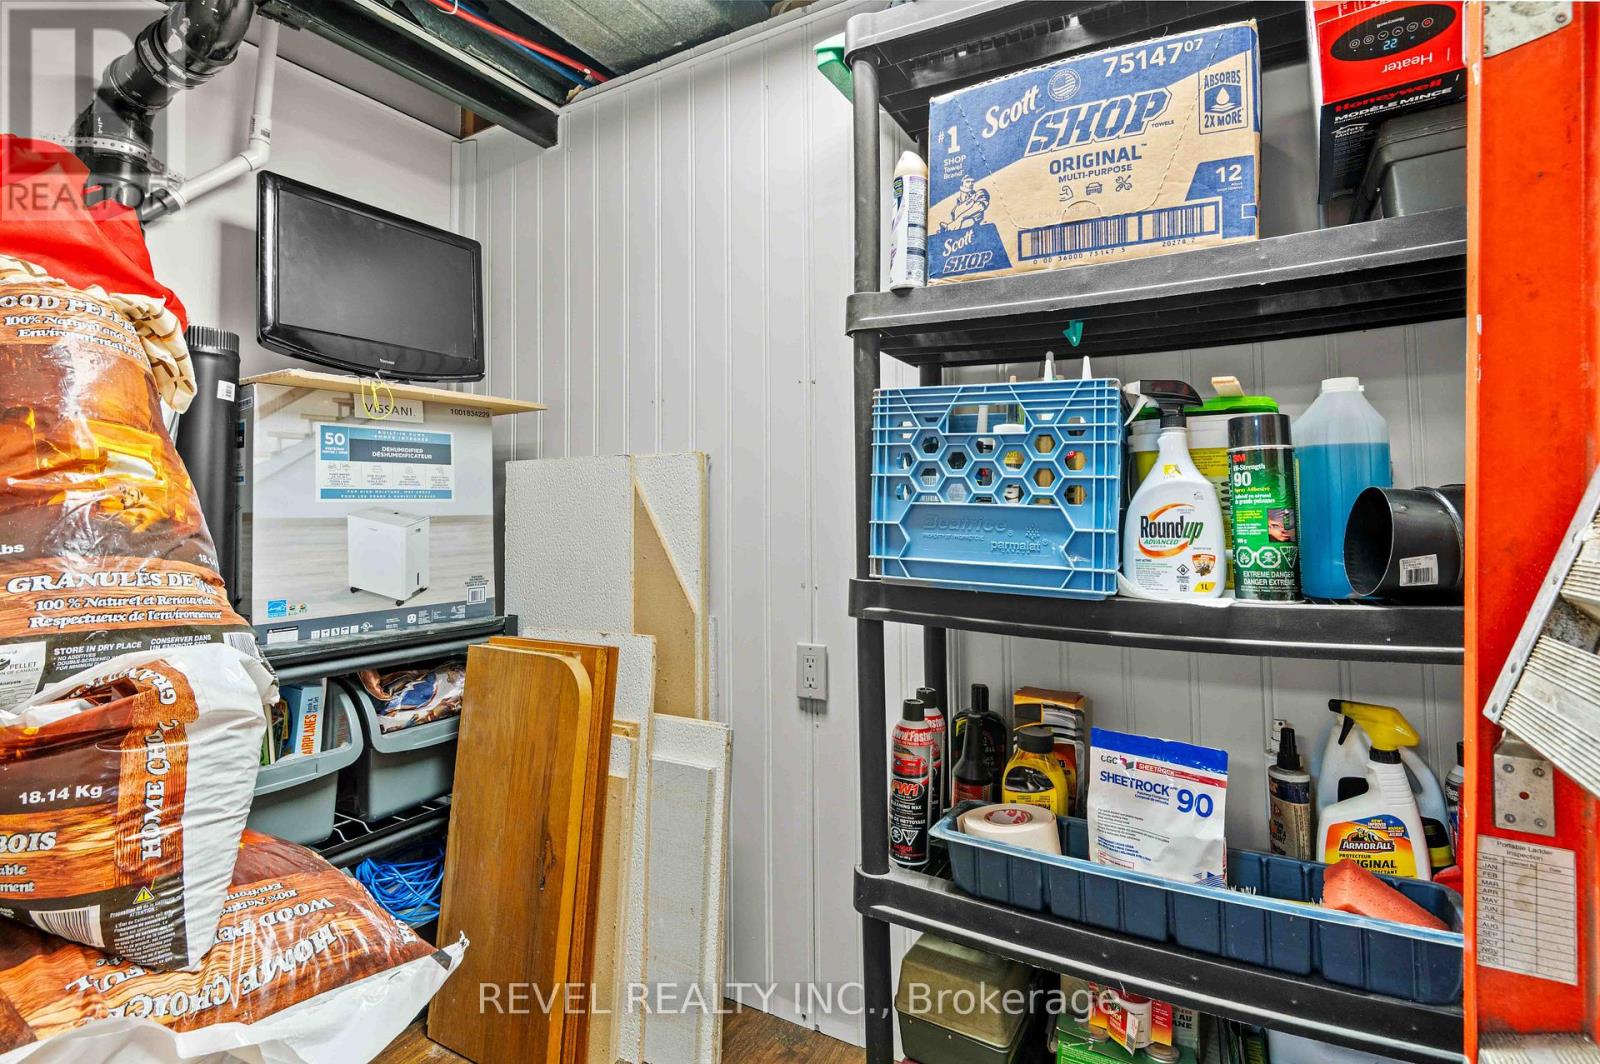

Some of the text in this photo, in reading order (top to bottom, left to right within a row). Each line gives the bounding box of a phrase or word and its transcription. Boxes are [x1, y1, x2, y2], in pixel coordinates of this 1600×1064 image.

[1383, 38, 1398, 51] 22
[1381, 52, 1433, 74] Heater
[1203, 69, 1241, 90] ABSORBS
[1335, 78, 1443, 112] Honeywell
[981, 84, 1041, 138] Scott
[1334, 87, 1453, 122] MODÈLE MINCE
[1023, 87, 1173, 158] SHOP
[1204, 109, 1242, 128] 2X MORE
[943, 154, 967, 168] SHOP
[943, 163, 963, 174] Towel
[1058, 163, 1133, 183] MULTI-PURPOSE
[1215, 164, 1242, 183] 12
[943, 229, 974, 257] Scott
[942, 250, 993, 274] SHOP
[4, 314, 41, 327] 100%
[449, 407, 490, 419] 1001834229
[324, 432, 346, 446] 50
[371, 451, 433, 460] DÉSHUMIDIFICATEUR
[381, 446, 424, 454] DEHUMIDIFIER
[1232, 453, 1247, 463] 3M
[1233, 471, 1252, 487] 90
[1140, 515, 1204, 546] Roundup
[990, 539, 1041, 553] parmalat
[167, 571, 193, 588] DE
[1243, 570, 1295, 579] EXTREME DANGER
[1243, 578, 1267, 586] DANGER
[35, 594, 156, 612] 100 % Naturel et
[28, 613, 127, 630] Respectueux
[128, 610, 146, 622] de
[53, 645, 85, 656] STORE
[97, 643, 115, 651] DRY
[116, 641, 142, 650] PLACE
[150, 637, 193, 646] CONSERVER
[9, 661, 37, 670] PELLET
[301, 713, 318, 755] AIRPLANES
[1101, 755, 1118, 765] CGC
[1138, 762, 1175, 777] SHEETROCK
[18, 784, 103, 805] 18.14 Kg
[1099, 770, 1170, 798] SHEETROCK
[1176, 788, 1214, 818] 90
[141, 779, 166, 861] HOME
[1497, 841, 1553, 855] Portable Ladder
[1506, 850, 1543, 861] Inspection
[1482, 871, 1498, 879] FEB
[1481, 880, 1499, 888] MAR
[268, 889, 298, 902] 100%
[1482, 896, 1498, 904] MAY
[259, 897, 336, 928] WOOD
[1483, 905, 1498, 913] JUN
[1483, 913, 1497, 921] JUL
[1482, 922, 1499, 930] AUG
[1481, 938, 1499, 947] OCT
[240, 922, 335, 996] HOME
